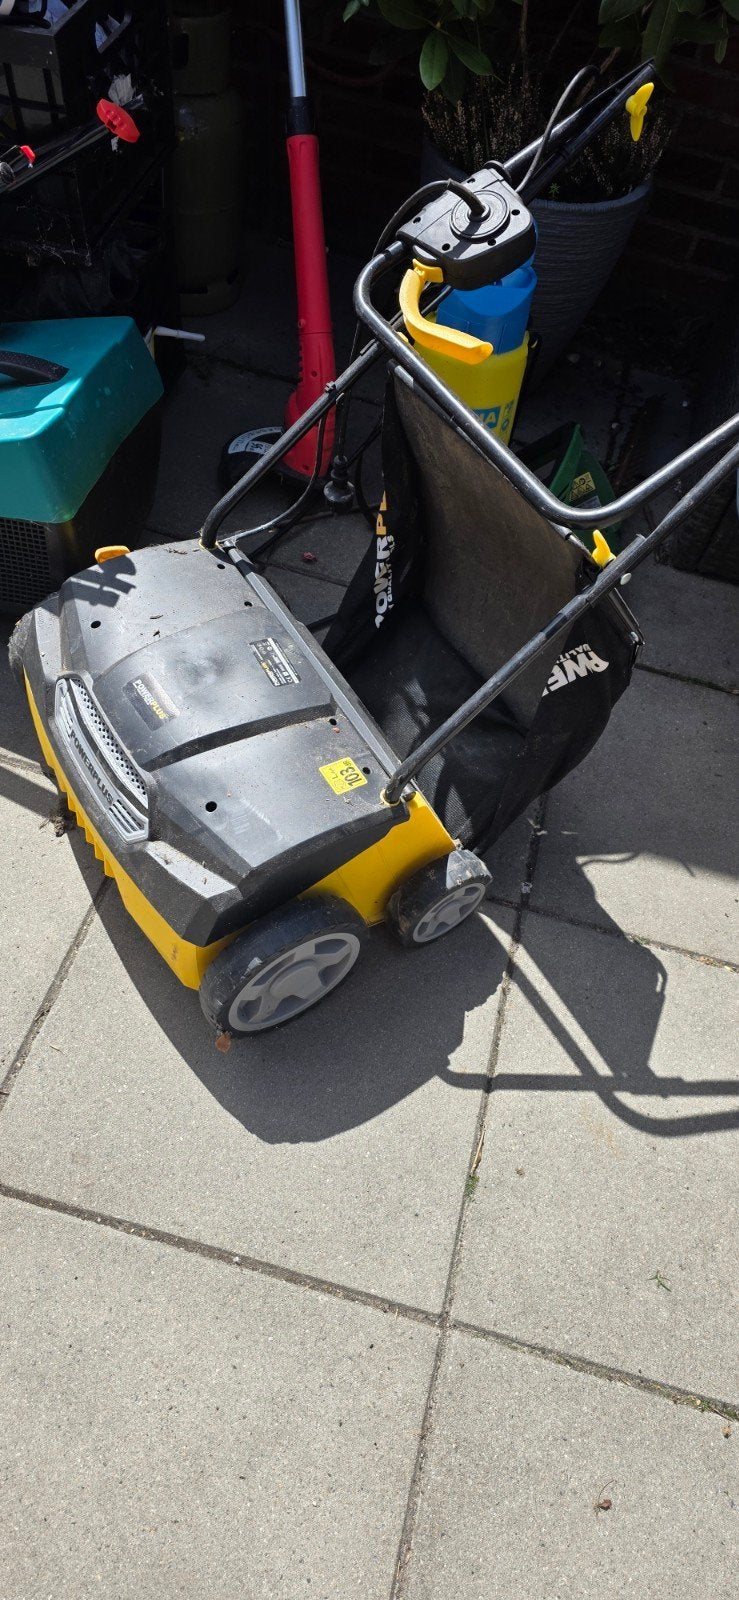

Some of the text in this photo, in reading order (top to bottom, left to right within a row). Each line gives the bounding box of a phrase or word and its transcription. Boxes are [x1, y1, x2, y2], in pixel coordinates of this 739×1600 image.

[133, 679, 167, 719] POWERPLUS
[69, 729, 113, 804] POWERPLUS
[340, 766, 363, 787] 103
